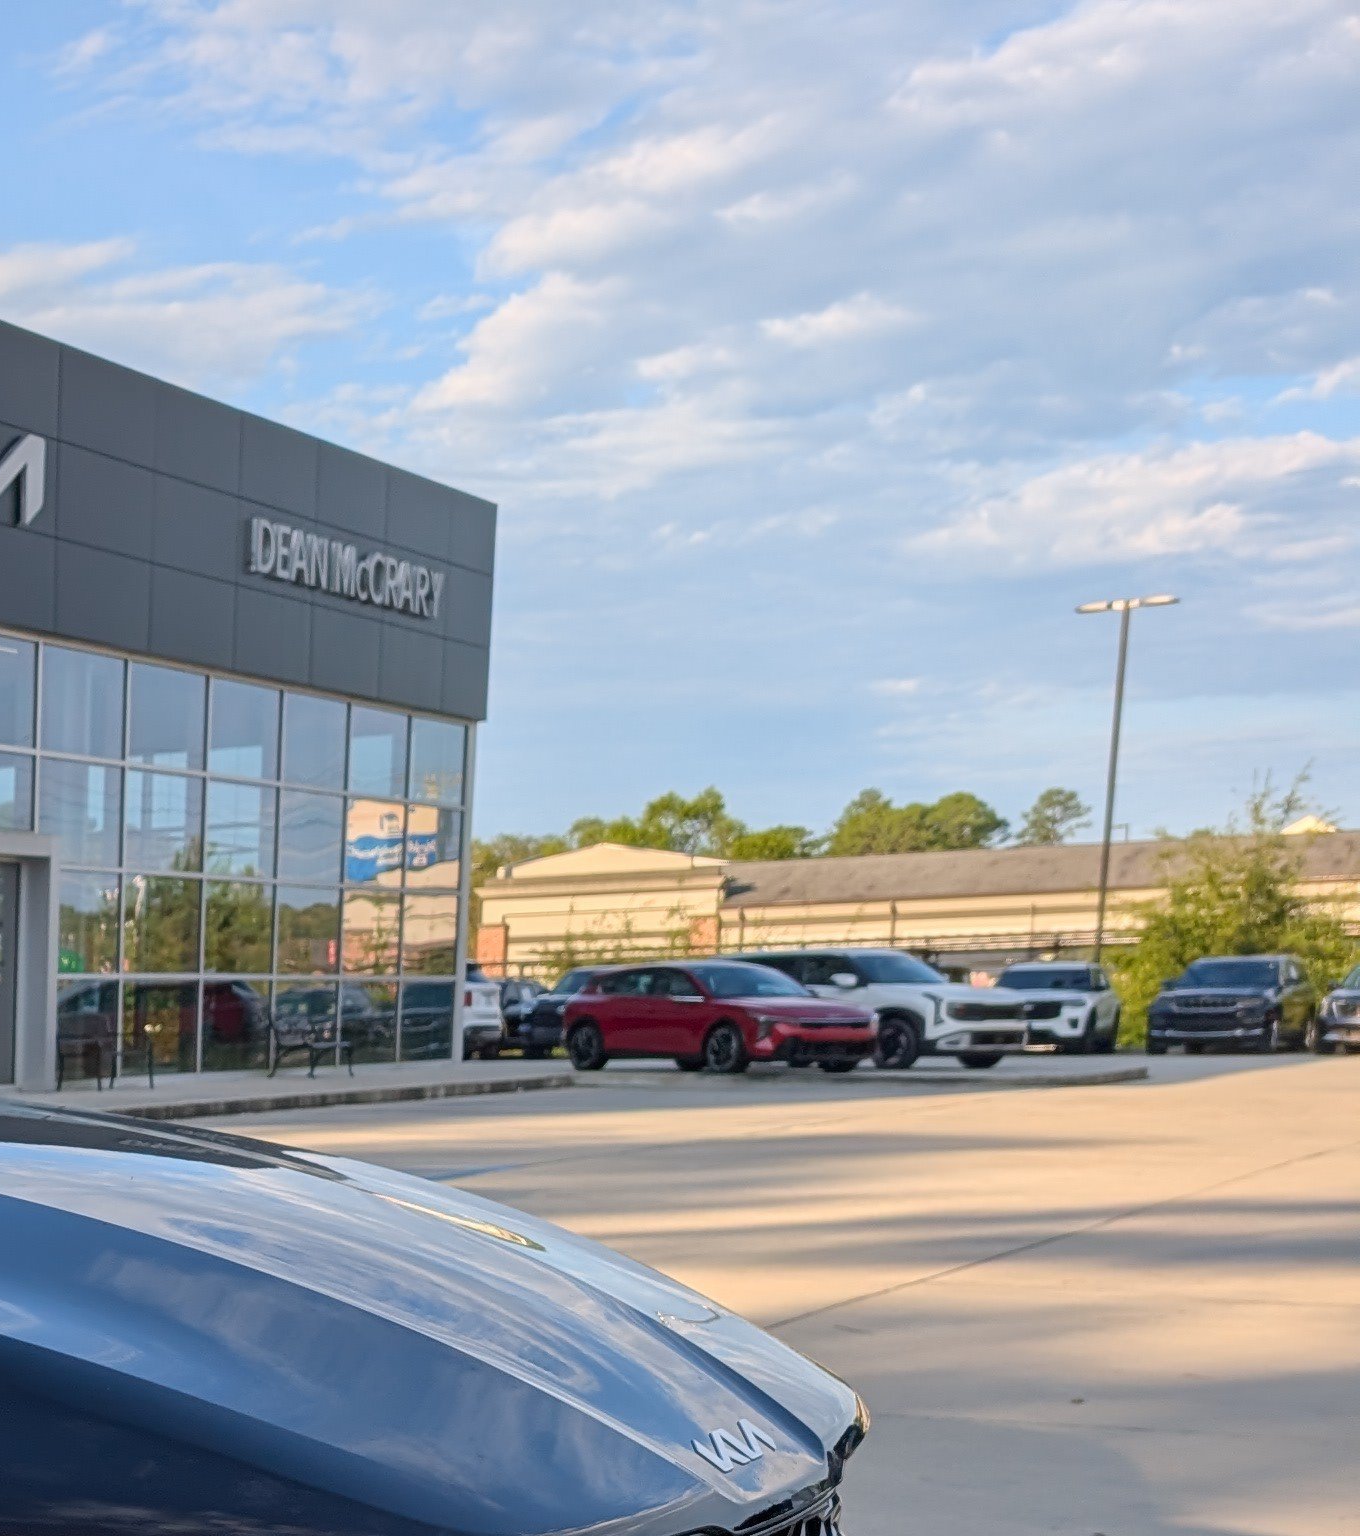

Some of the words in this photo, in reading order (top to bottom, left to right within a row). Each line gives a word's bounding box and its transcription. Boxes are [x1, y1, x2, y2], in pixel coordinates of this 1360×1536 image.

[250, 517, 329, 591] DEAN
[330, 540, 444, 620] McCRARY
[690, 1418, 777, 1474] KIA
